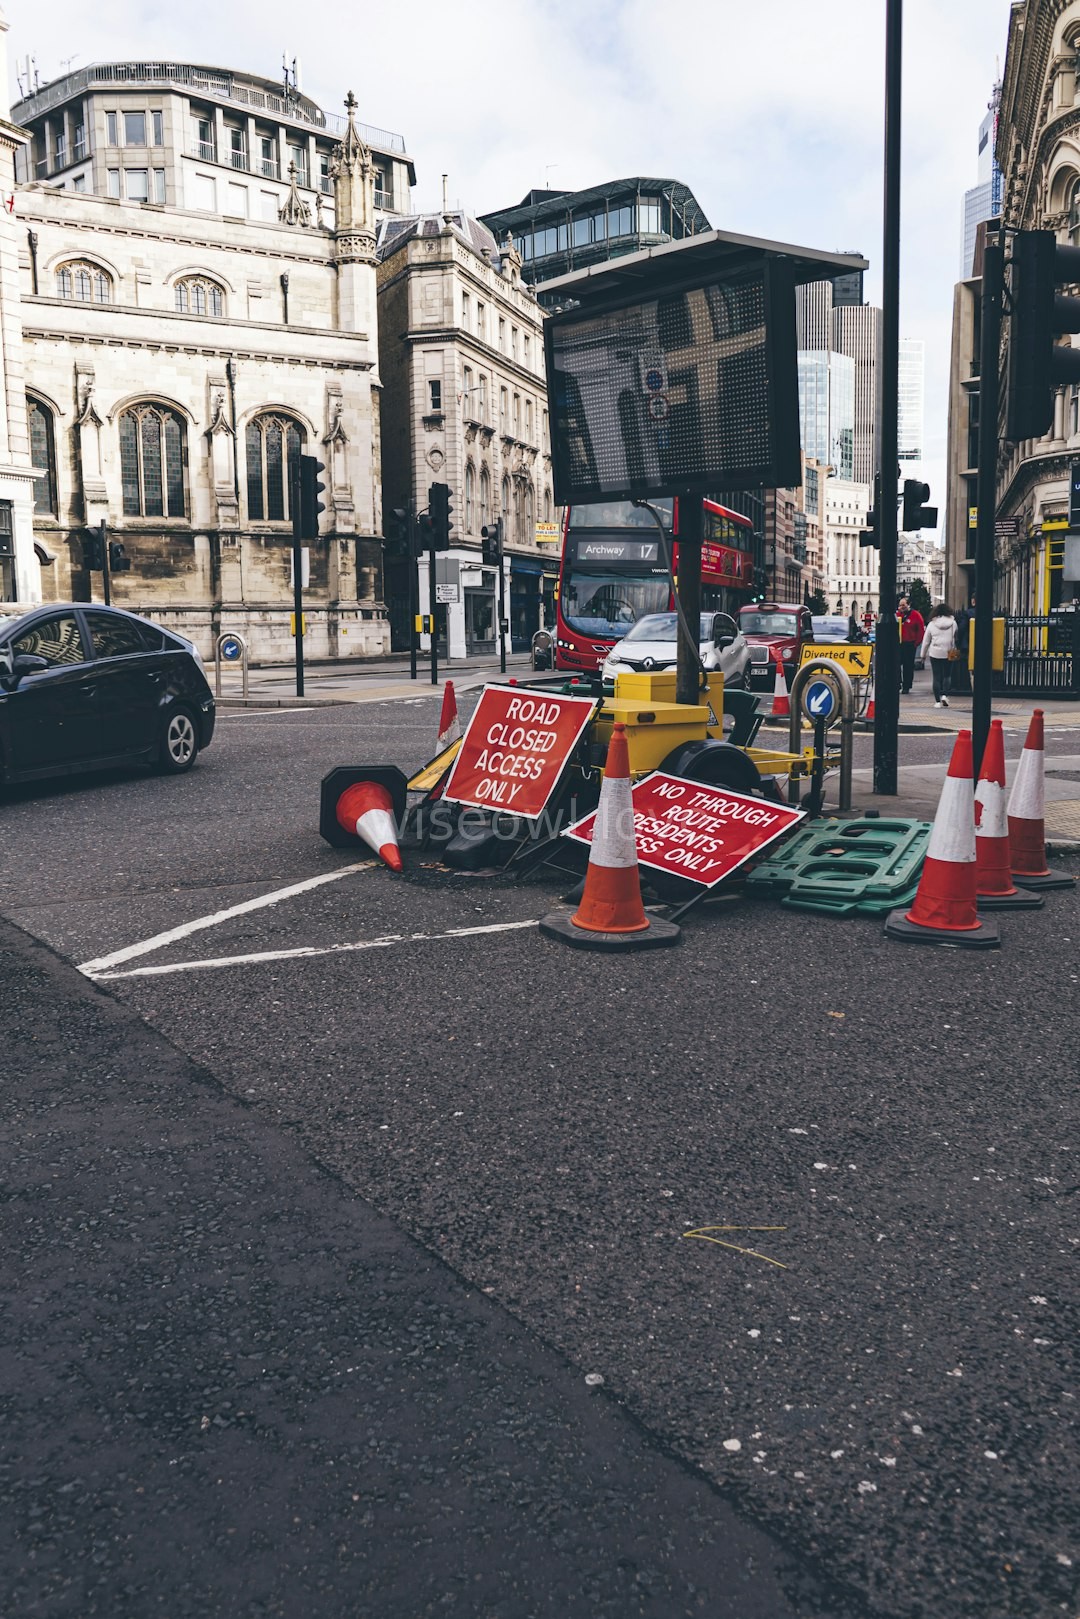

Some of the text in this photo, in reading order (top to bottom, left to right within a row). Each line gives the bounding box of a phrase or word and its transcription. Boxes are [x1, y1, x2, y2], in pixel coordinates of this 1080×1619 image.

[585, 545, 653, 559] Archway 17
[804, 650, 846, 660] Diverted
[506, 698, 561, 725] ROAD
[487, 723, 557, 753] CLOSED
[474, 749, 546, 780] ACCESS
[475, 779, 523, 805] ONLY
[652, 782, 779, 828] NO THROUGH
[662, 804, 727, 834] ROUTE
[664, 847, 722, 874] ONLY
